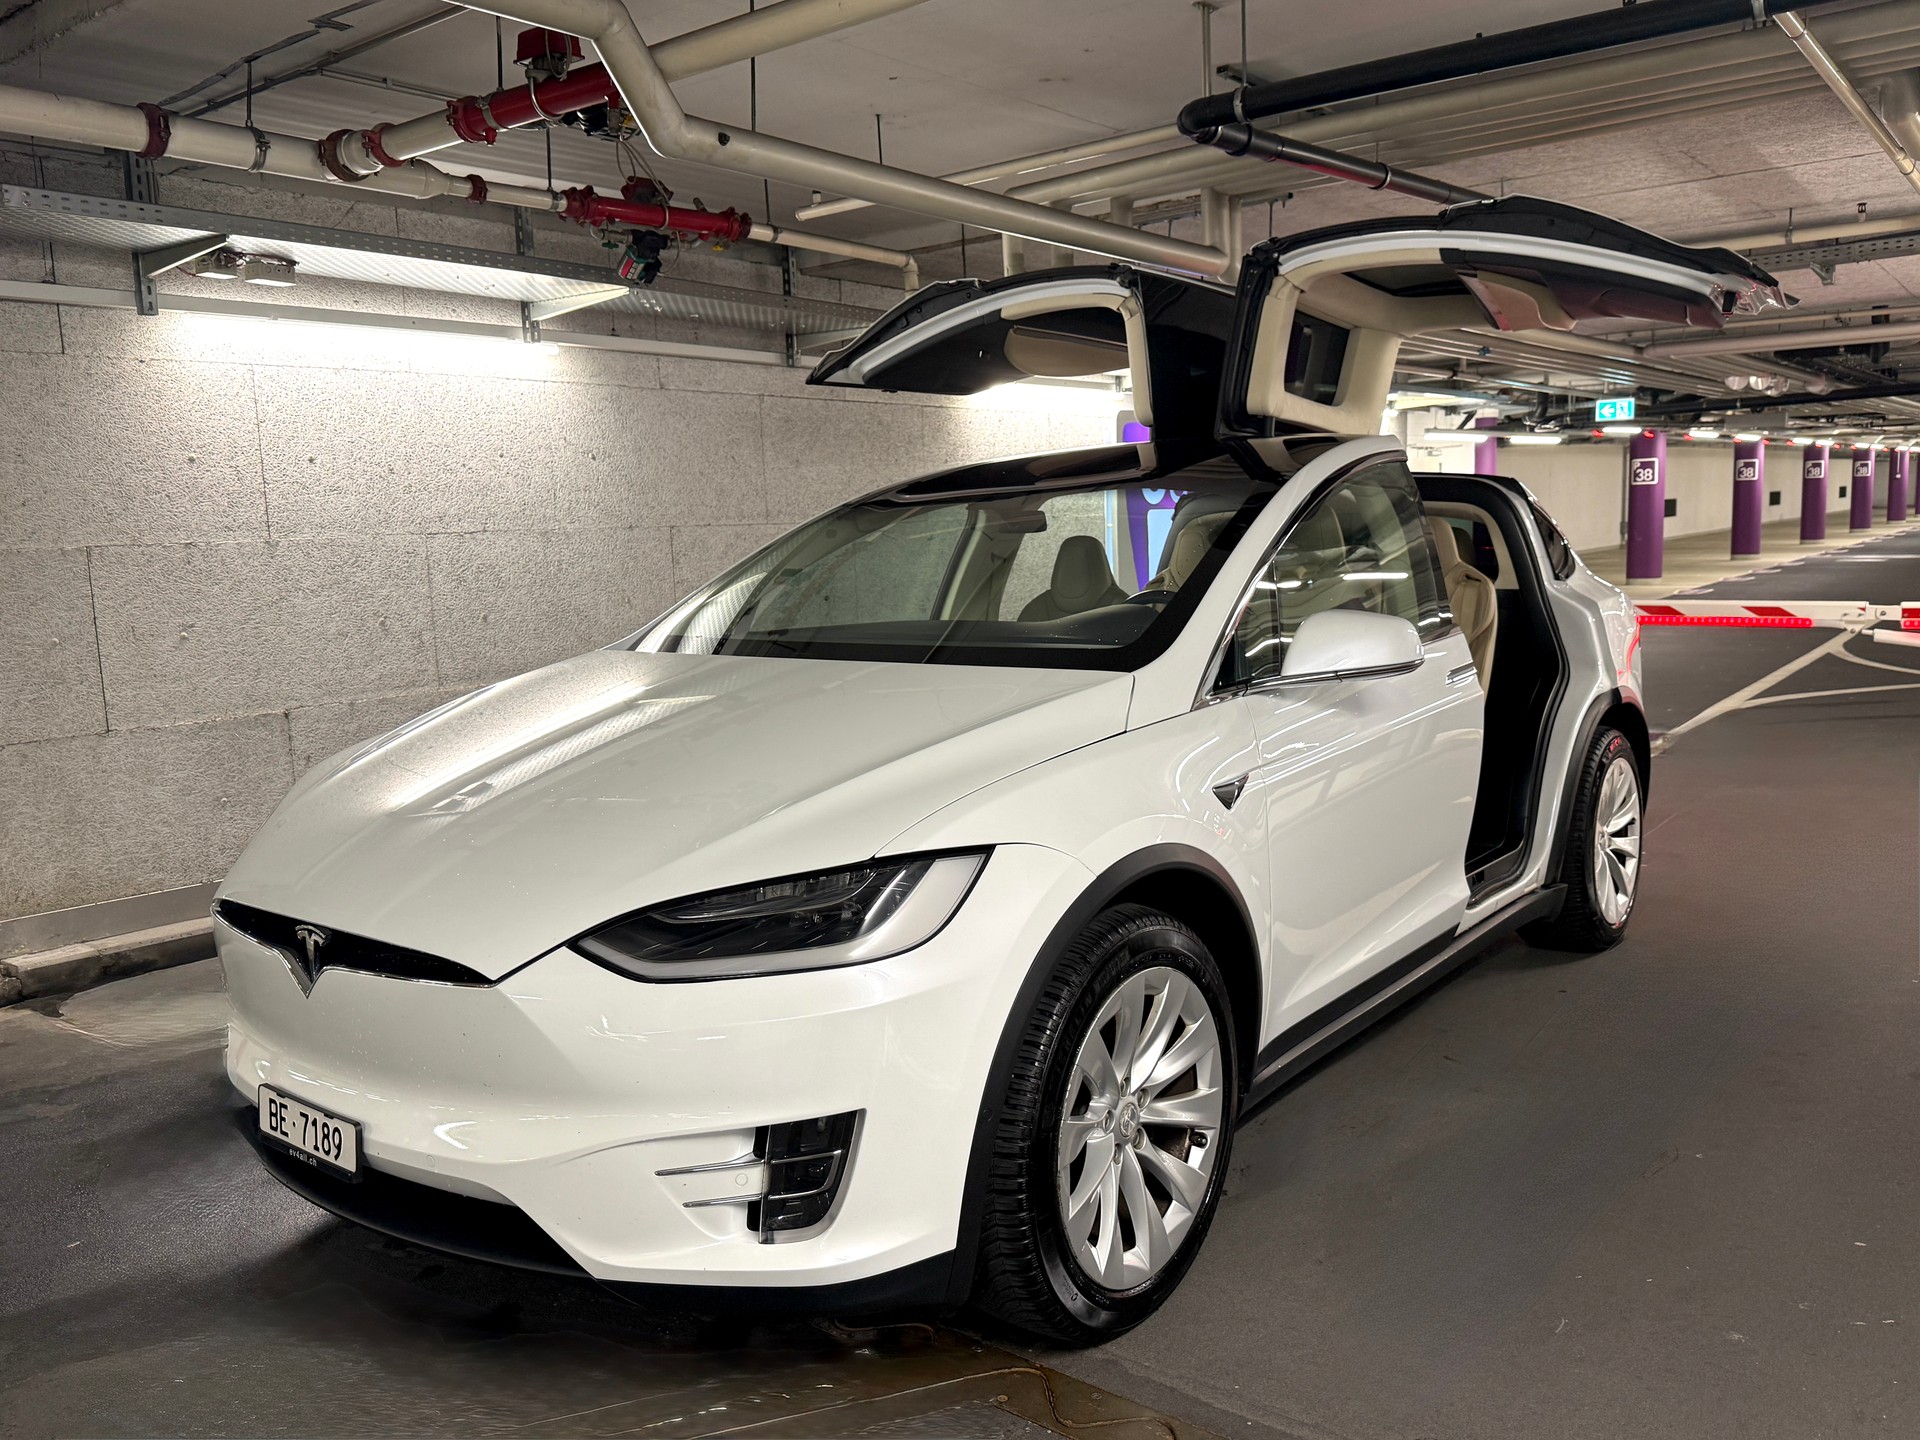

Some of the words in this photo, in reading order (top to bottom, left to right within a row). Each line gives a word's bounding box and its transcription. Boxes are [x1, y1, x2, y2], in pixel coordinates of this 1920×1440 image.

[1636, 468, 1653, 481] 38
[1739, 467, 1754, 478] 38
[1808, 467, 1820, 476] 38
[1857, 466, 1868, 475] 38
[289, 1148, 317, 1166] ev4all.ch
